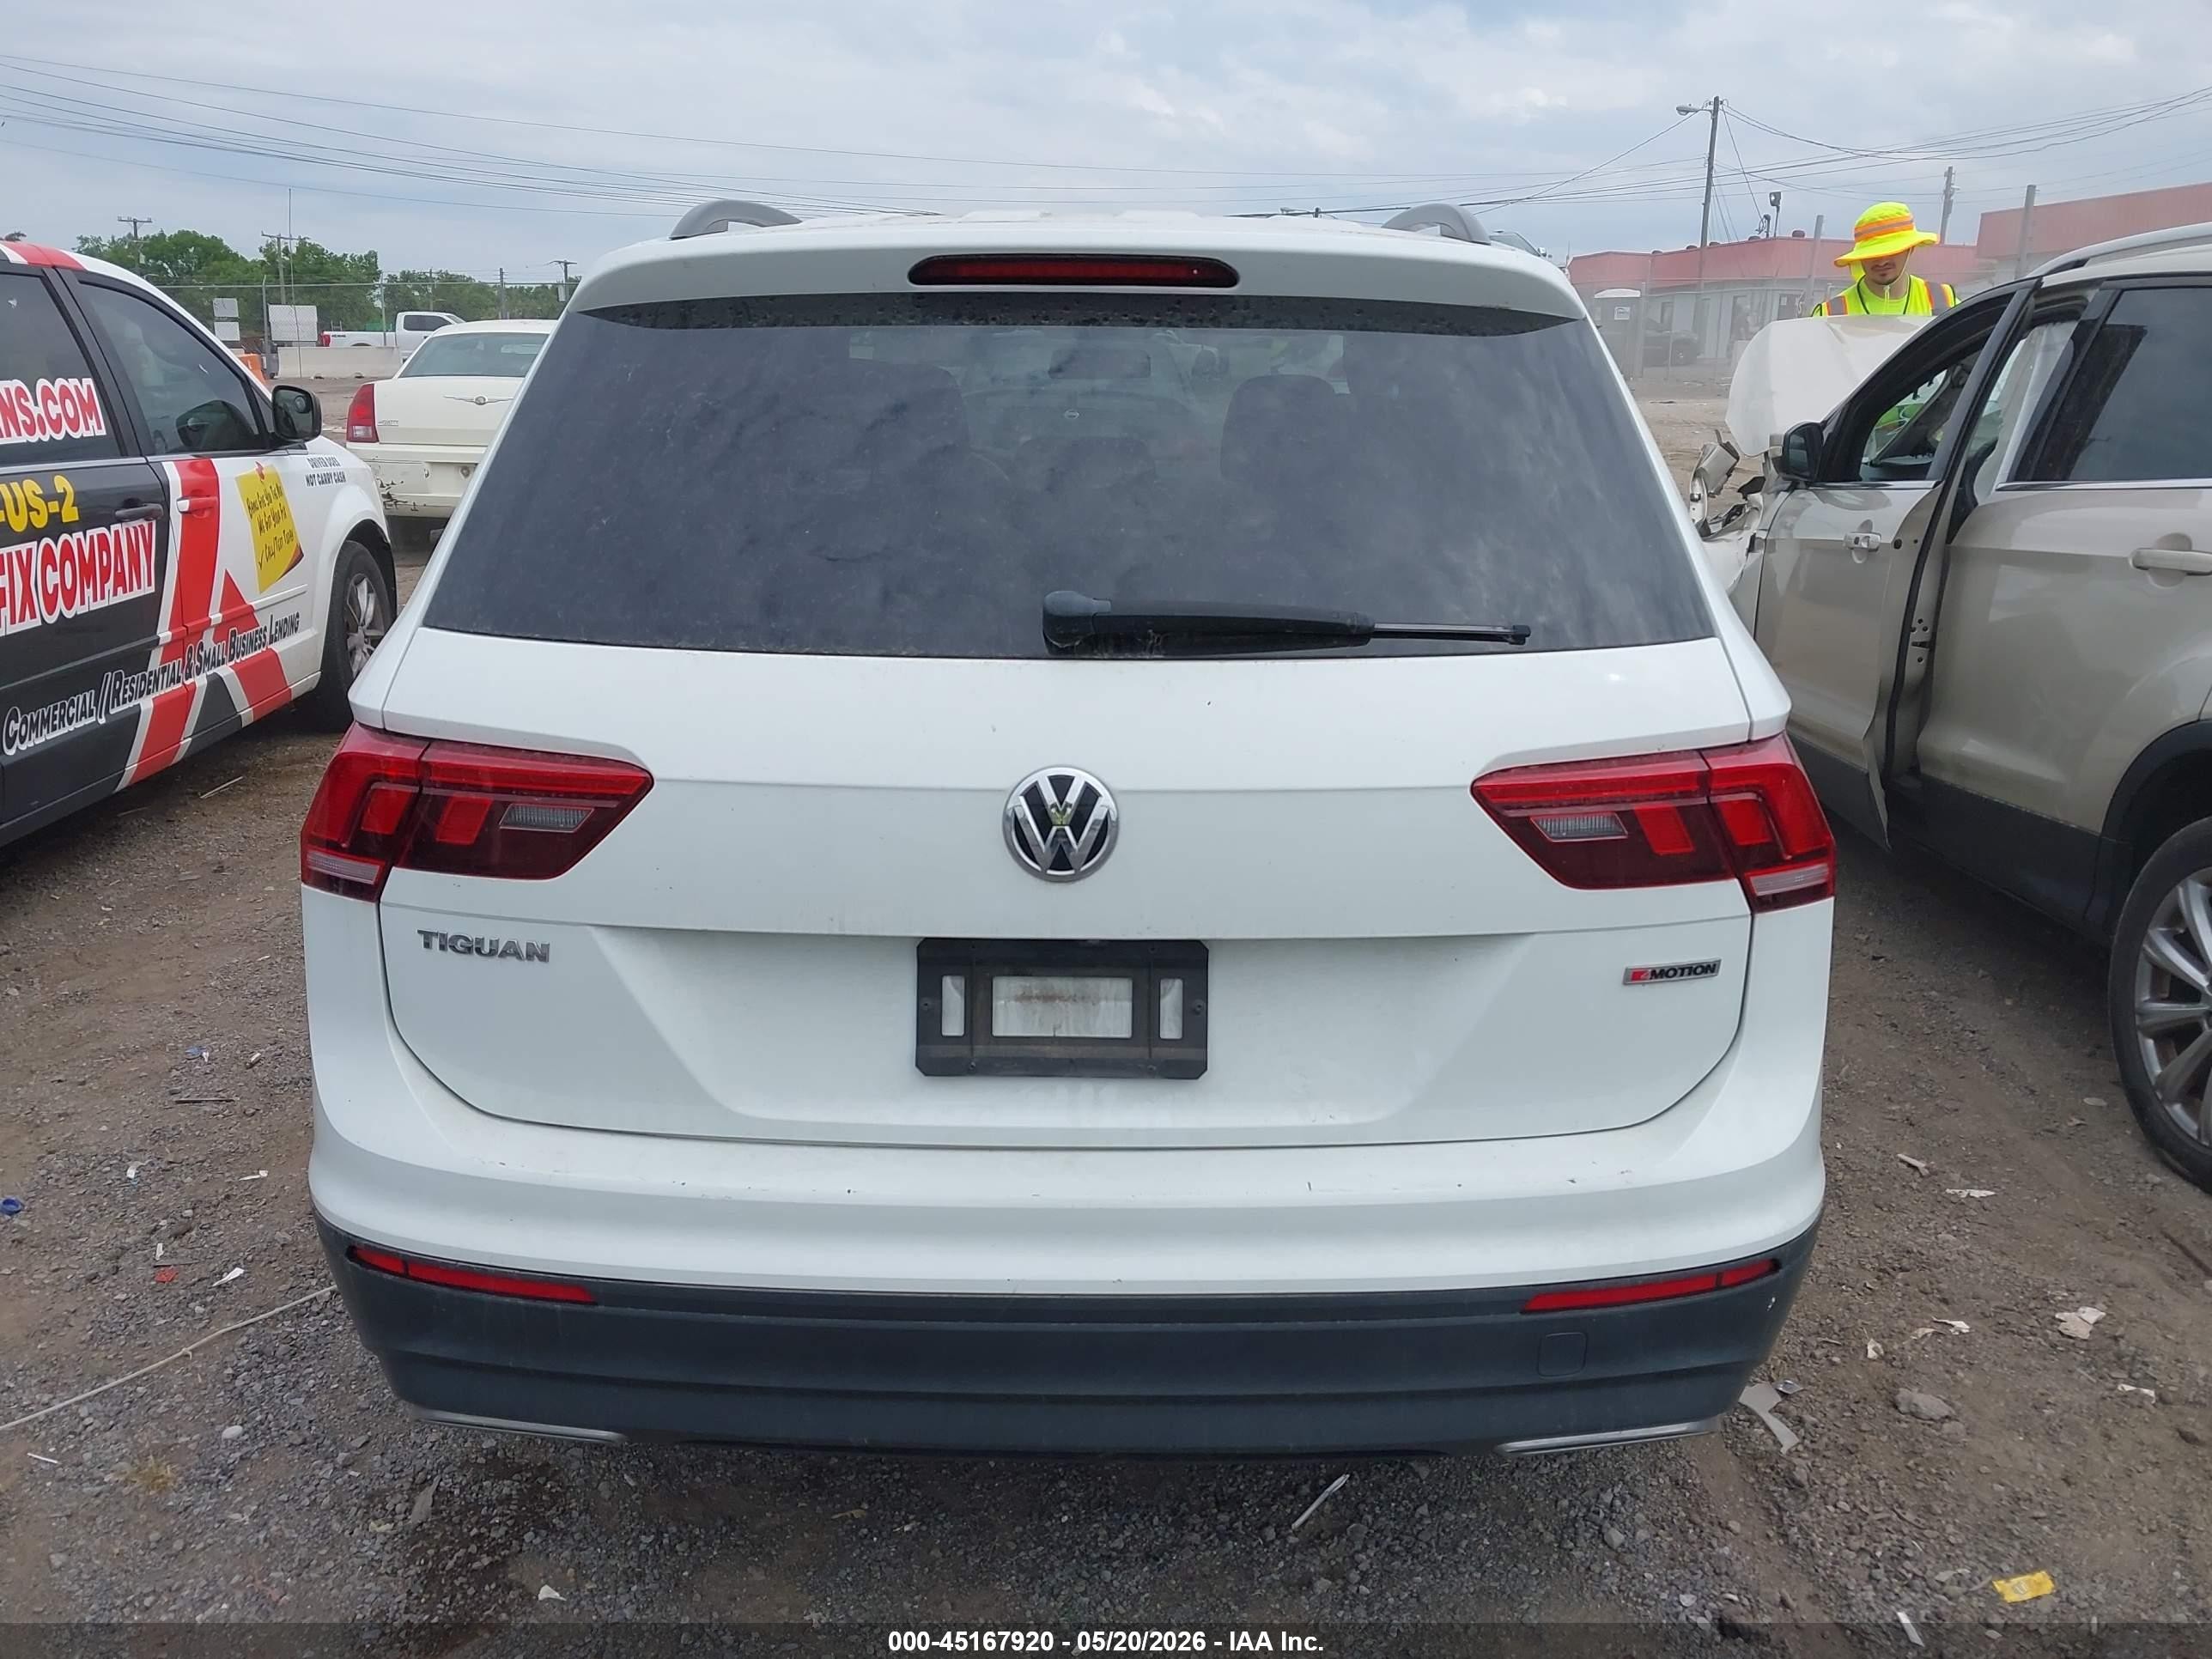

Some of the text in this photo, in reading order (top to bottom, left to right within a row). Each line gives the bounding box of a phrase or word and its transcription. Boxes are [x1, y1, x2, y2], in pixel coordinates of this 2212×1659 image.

[0, 381, 104, 441] NS.COM
[305, 471, 346, 487] NOT CARRY CASH
[40, 520, 155, 620] COMPANY
[185, 644, 195, 683] &
[195, 641, 226, 676] SMALL
[228, 625, 268, 664] BUSINESS
[268, 611, 300, 645] LENDING
[416, 929, 550, 963] TIGUAN
